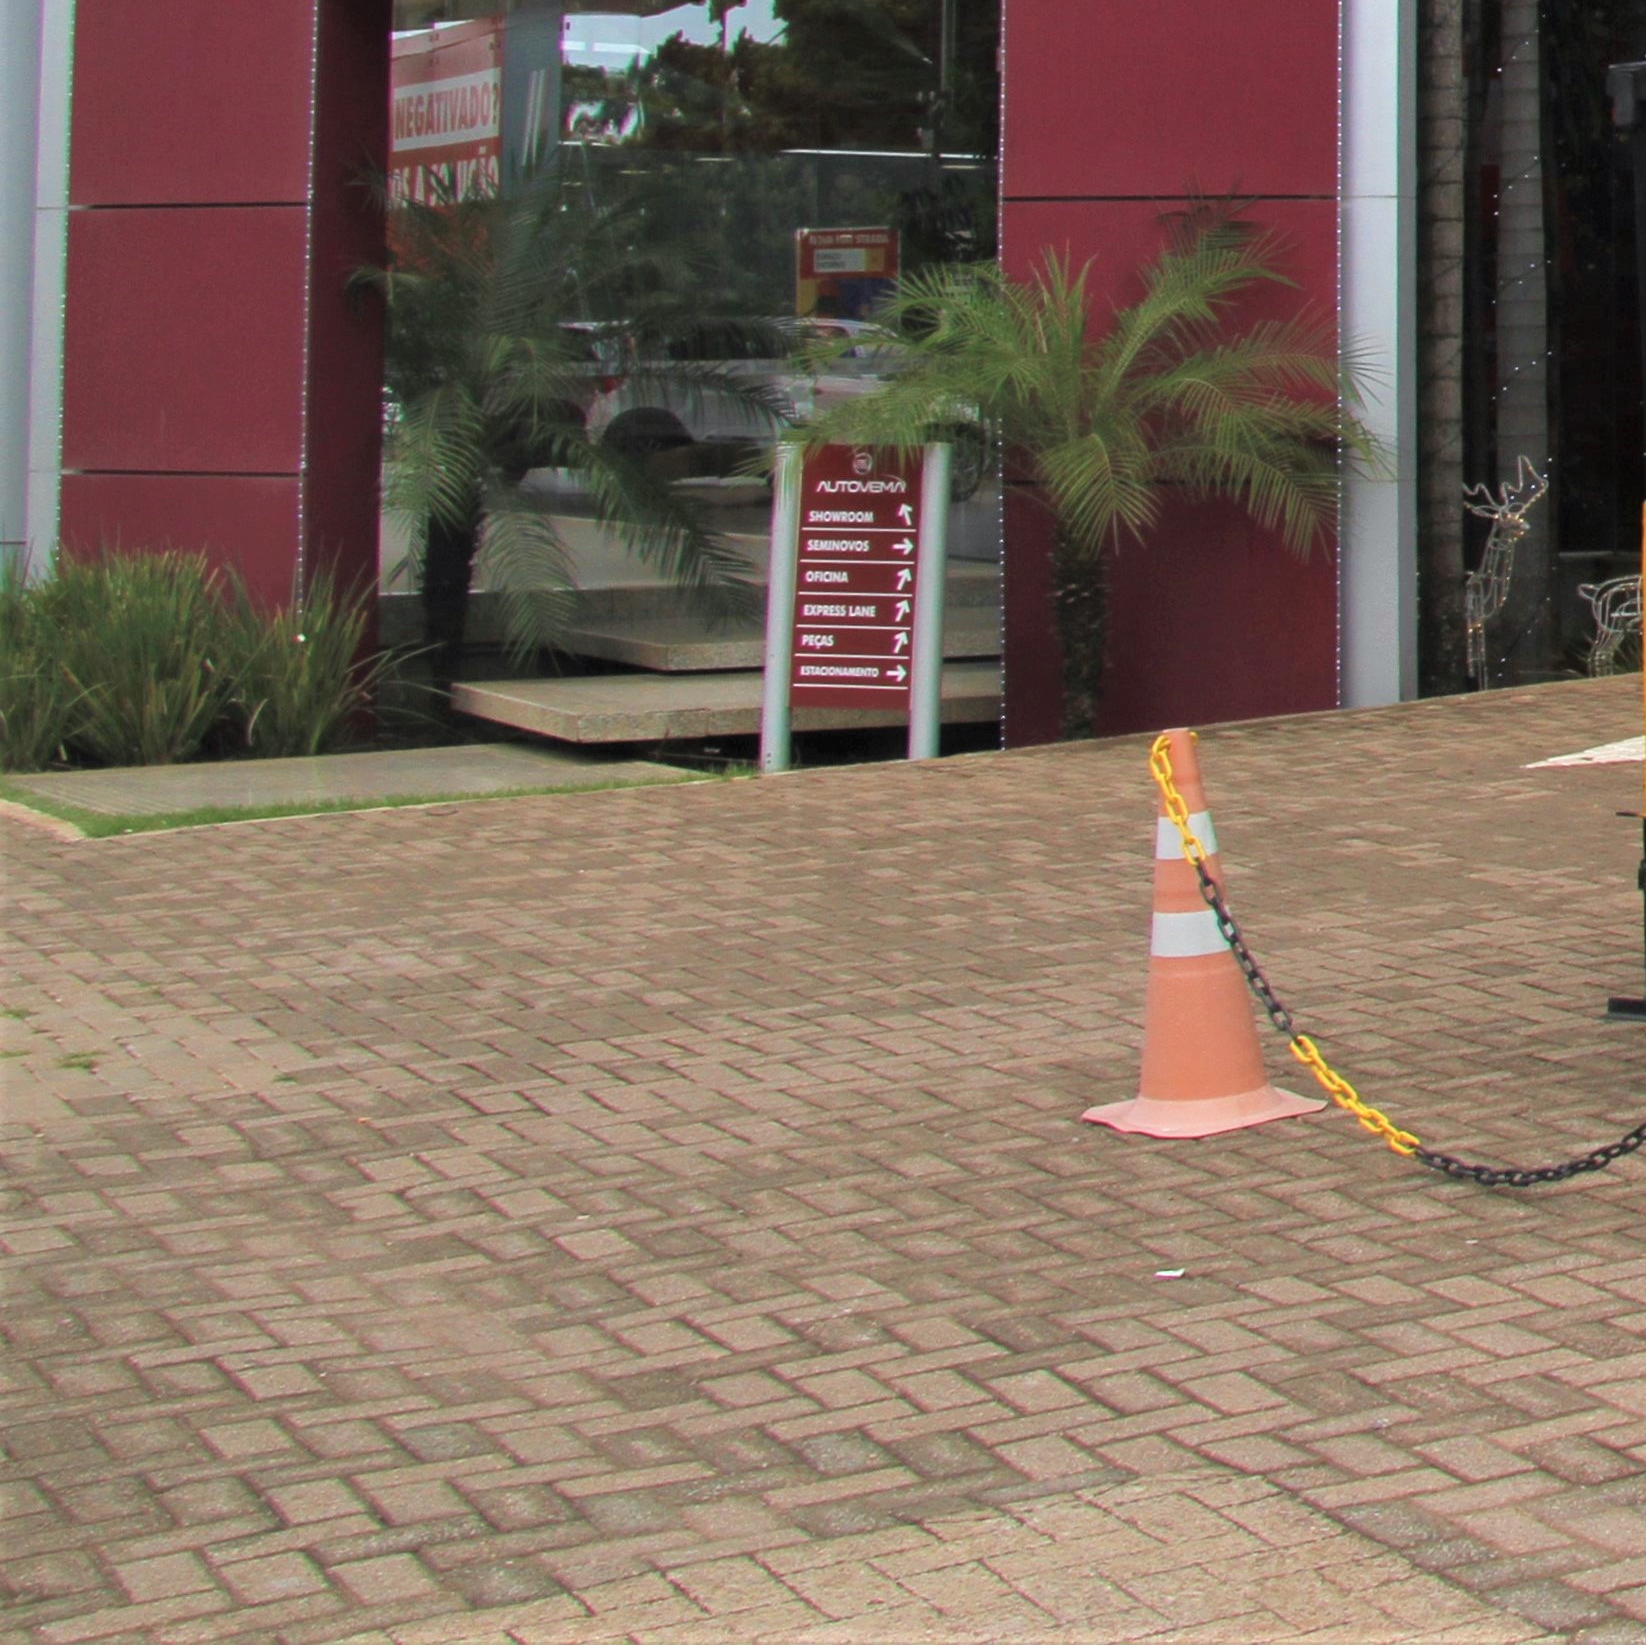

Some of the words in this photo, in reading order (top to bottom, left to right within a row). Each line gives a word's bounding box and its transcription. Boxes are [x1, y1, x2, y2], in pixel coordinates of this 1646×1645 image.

[816, 480, 907, 493] AUTOVEMA
[808, 510, 874, 523] SHOWROOM
[807, 539, 870, 552] SEMINOVOS
[805, 570, 849, 583] OFICINA
[803, 604, 846, 616] EXPRESS
[849, 605, 876, 617] LANE
[802, 634, 834, 650] PEÇAS
[800, 665, 879, 678] ESTACIONAMENTO
